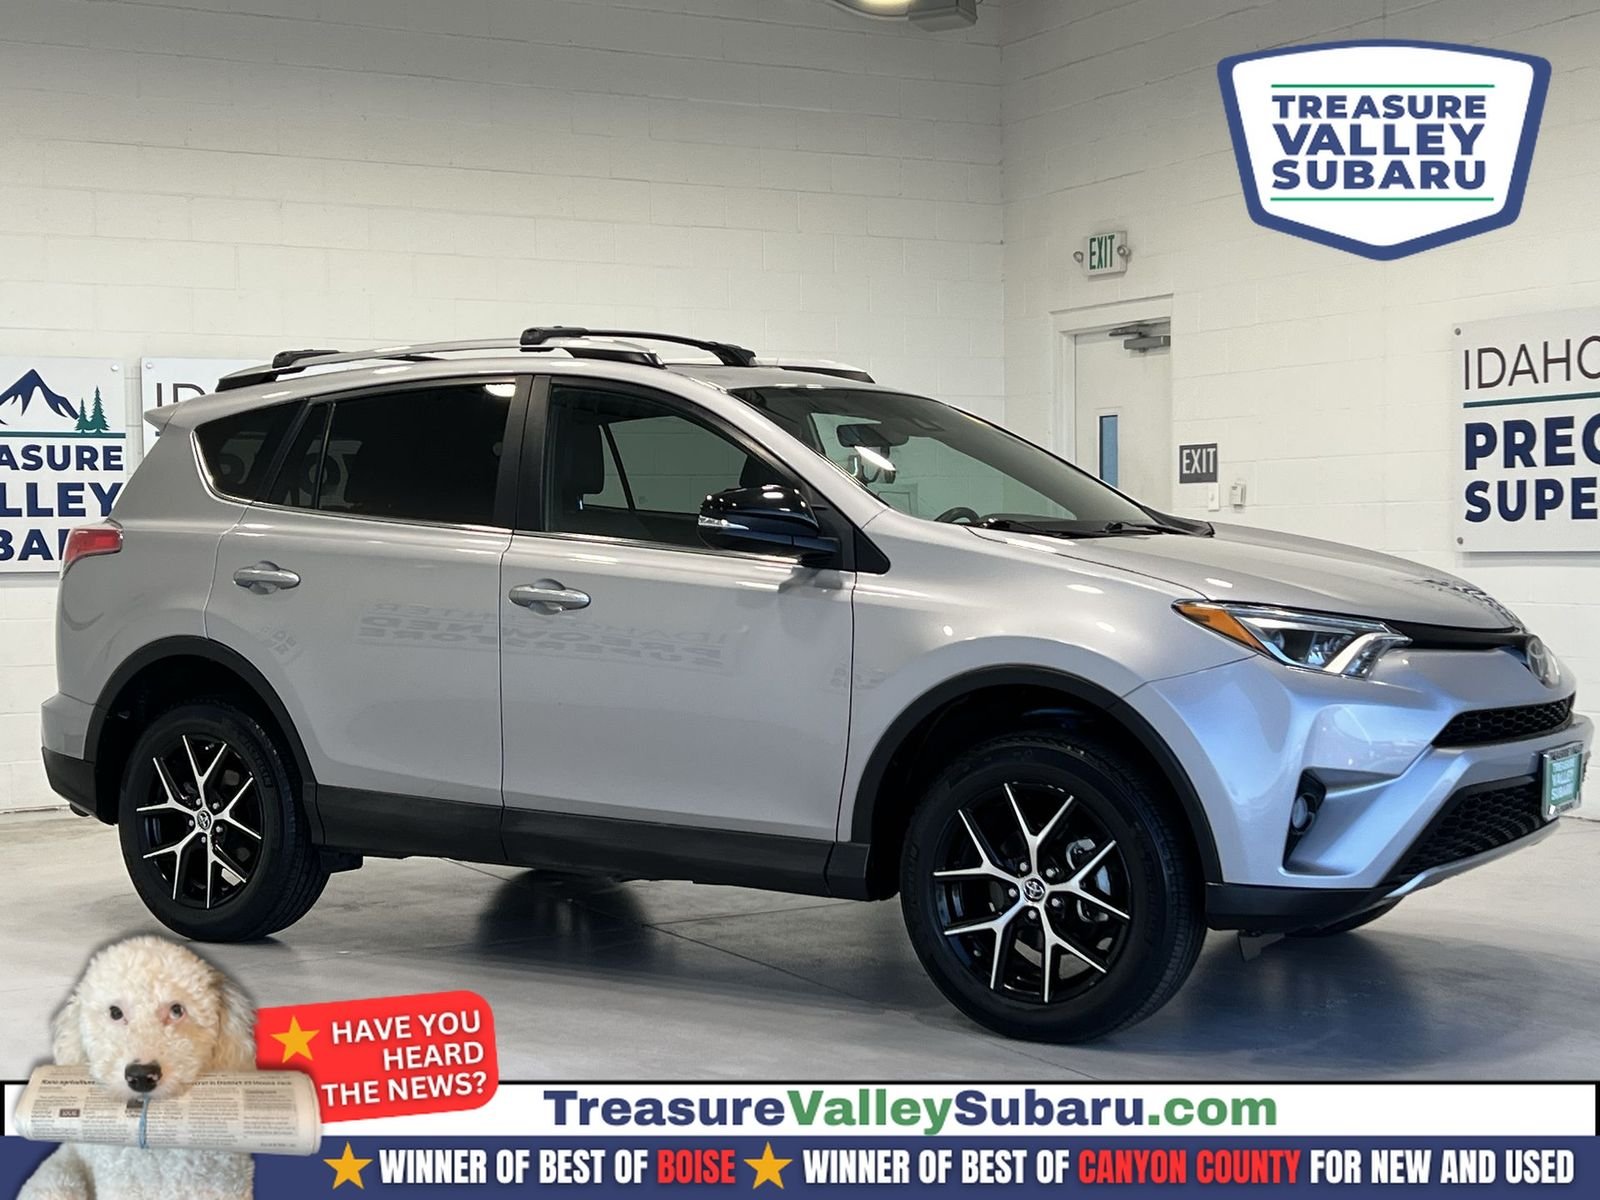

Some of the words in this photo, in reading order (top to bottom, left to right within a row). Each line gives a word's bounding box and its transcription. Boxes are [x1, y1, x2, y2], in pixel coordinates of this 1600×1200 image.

[1088, 234, 1115, 270] EXIT
[1182, 447, 1216, 474] EXIT
[1464, 476, 1598, 523] SUPE
